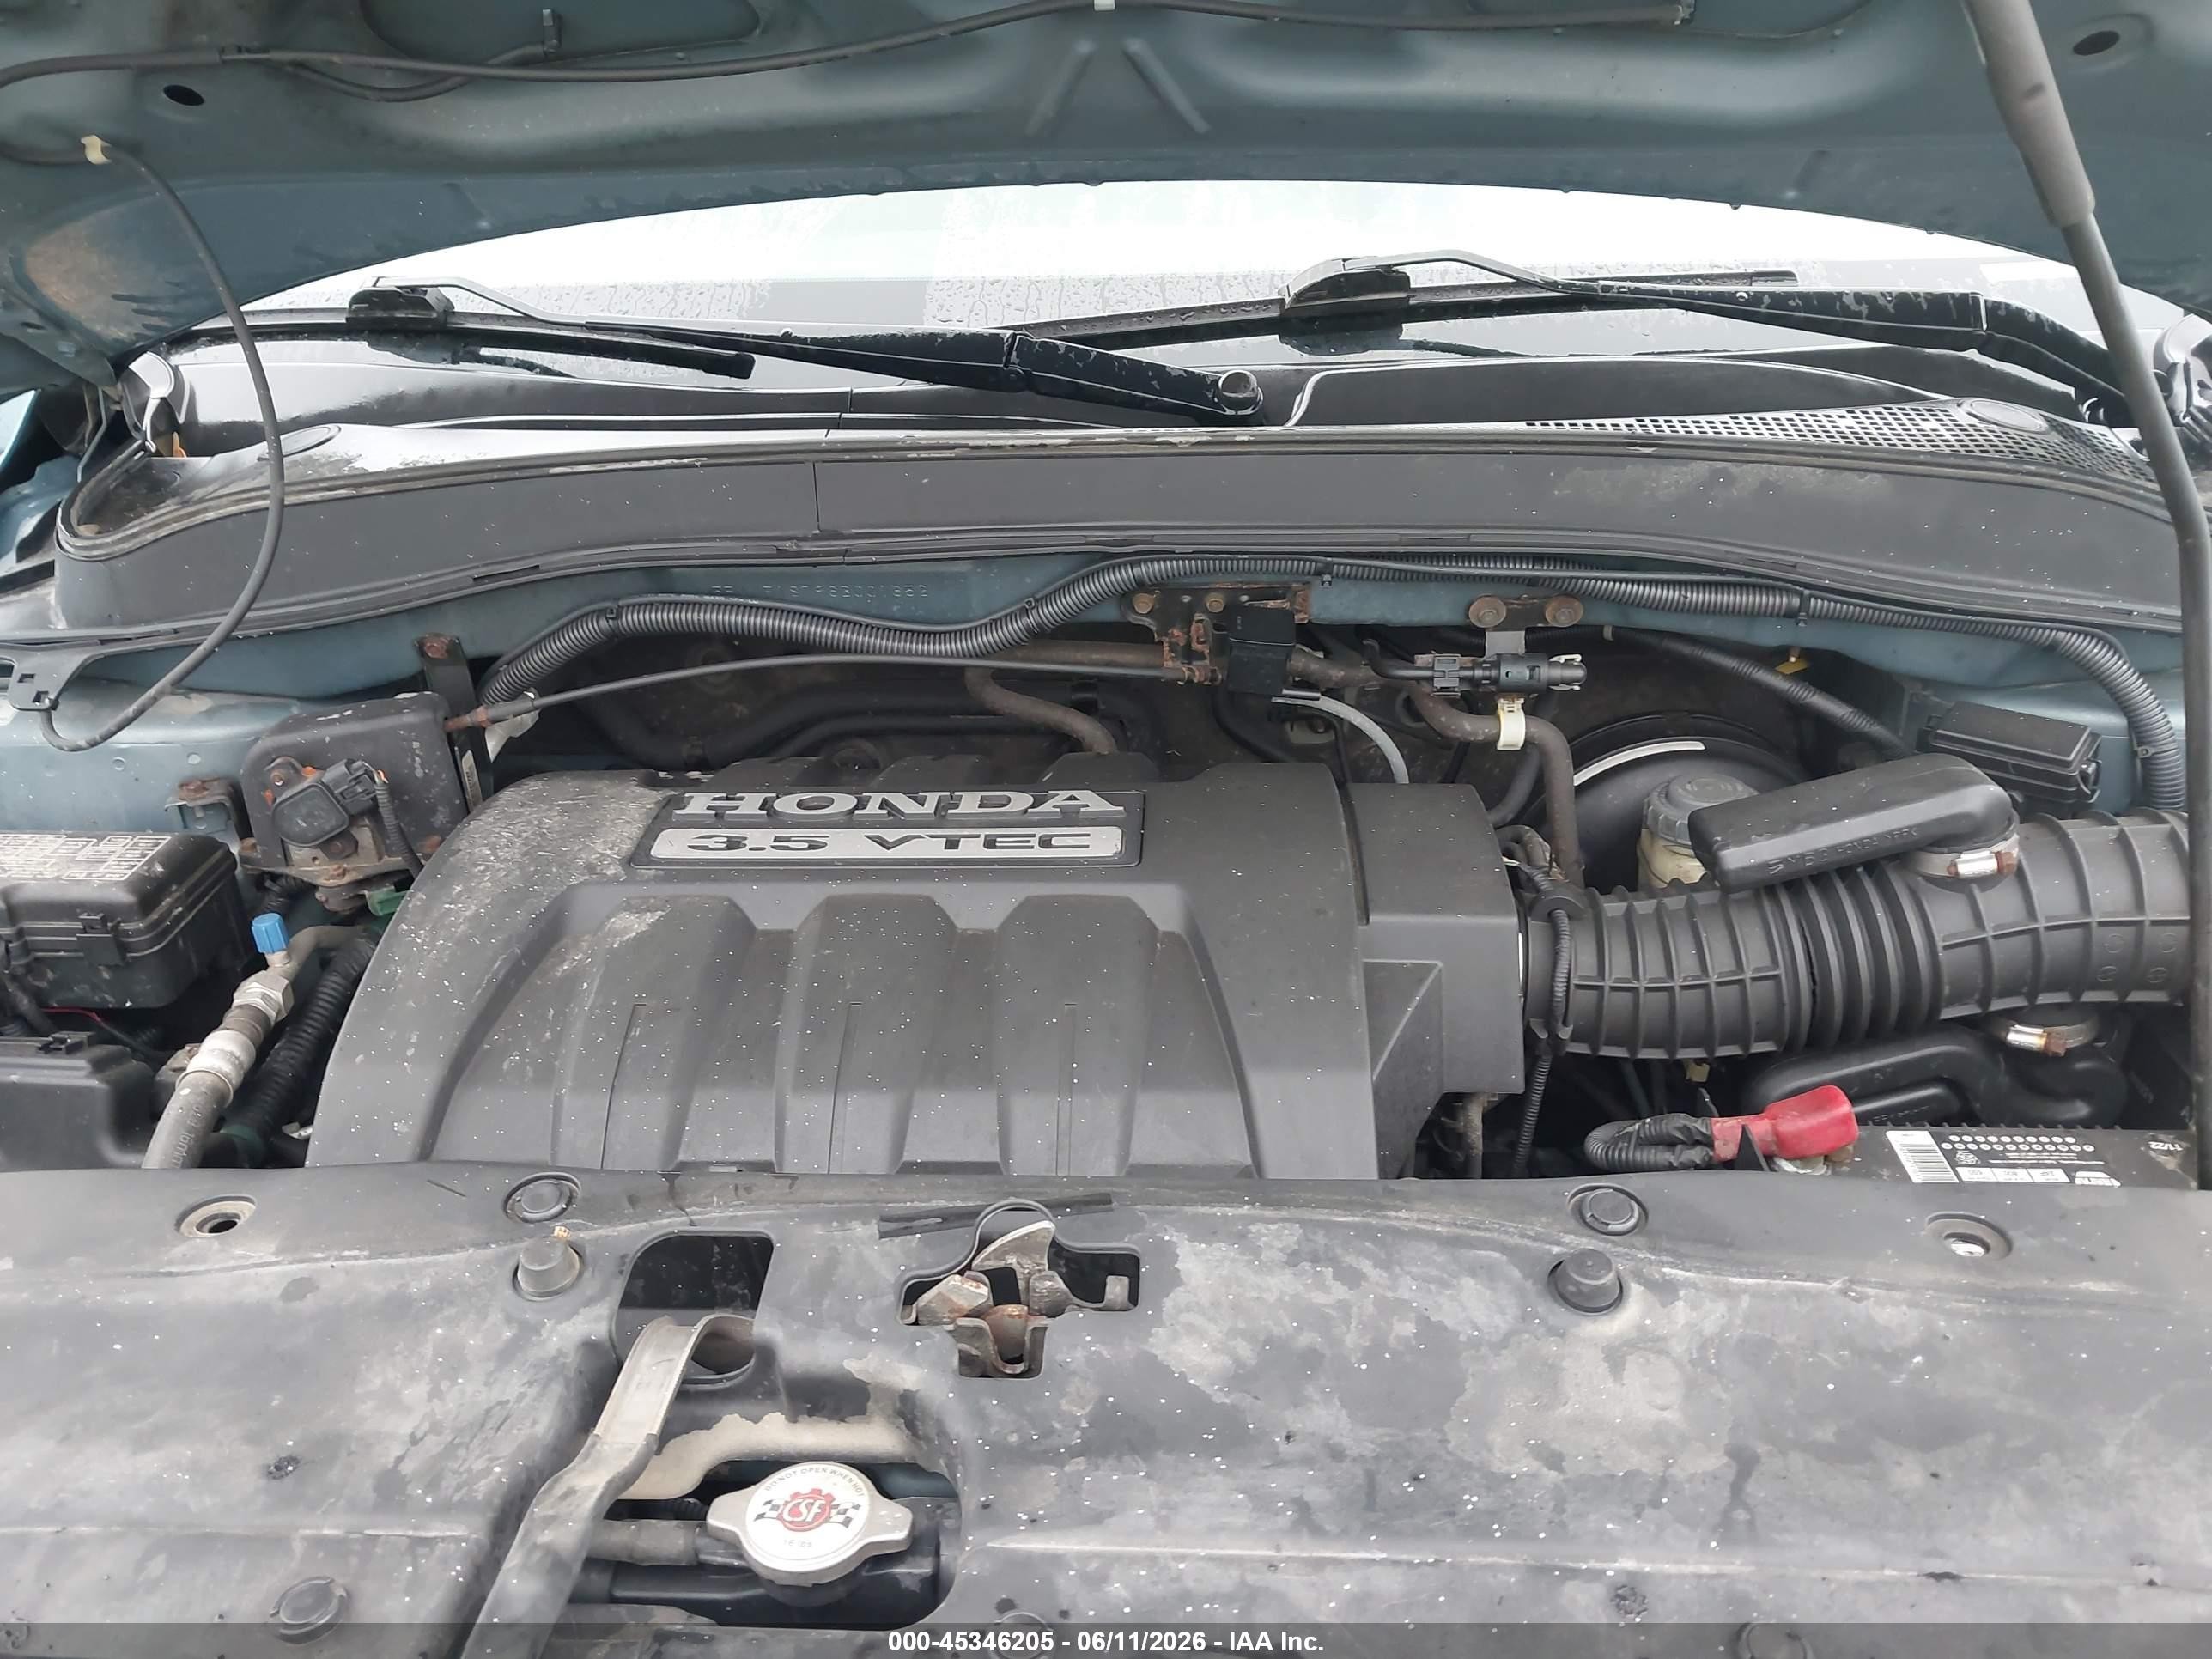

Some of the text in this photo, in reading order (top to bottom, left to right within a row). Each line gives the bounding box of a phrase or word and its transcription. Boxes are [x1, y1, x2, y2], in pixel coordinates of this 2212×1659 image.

[673, 790, 1125, 819] HONDA
[686, 833, 1091, 852] 3.5 VTEC
[778, 1470, 798, 1480] NOT
[830, 1469, 854, 1484] WHEN
[851, 1482, 865, 1497] HOT
[782, 1498, 826, 1522] CSF
